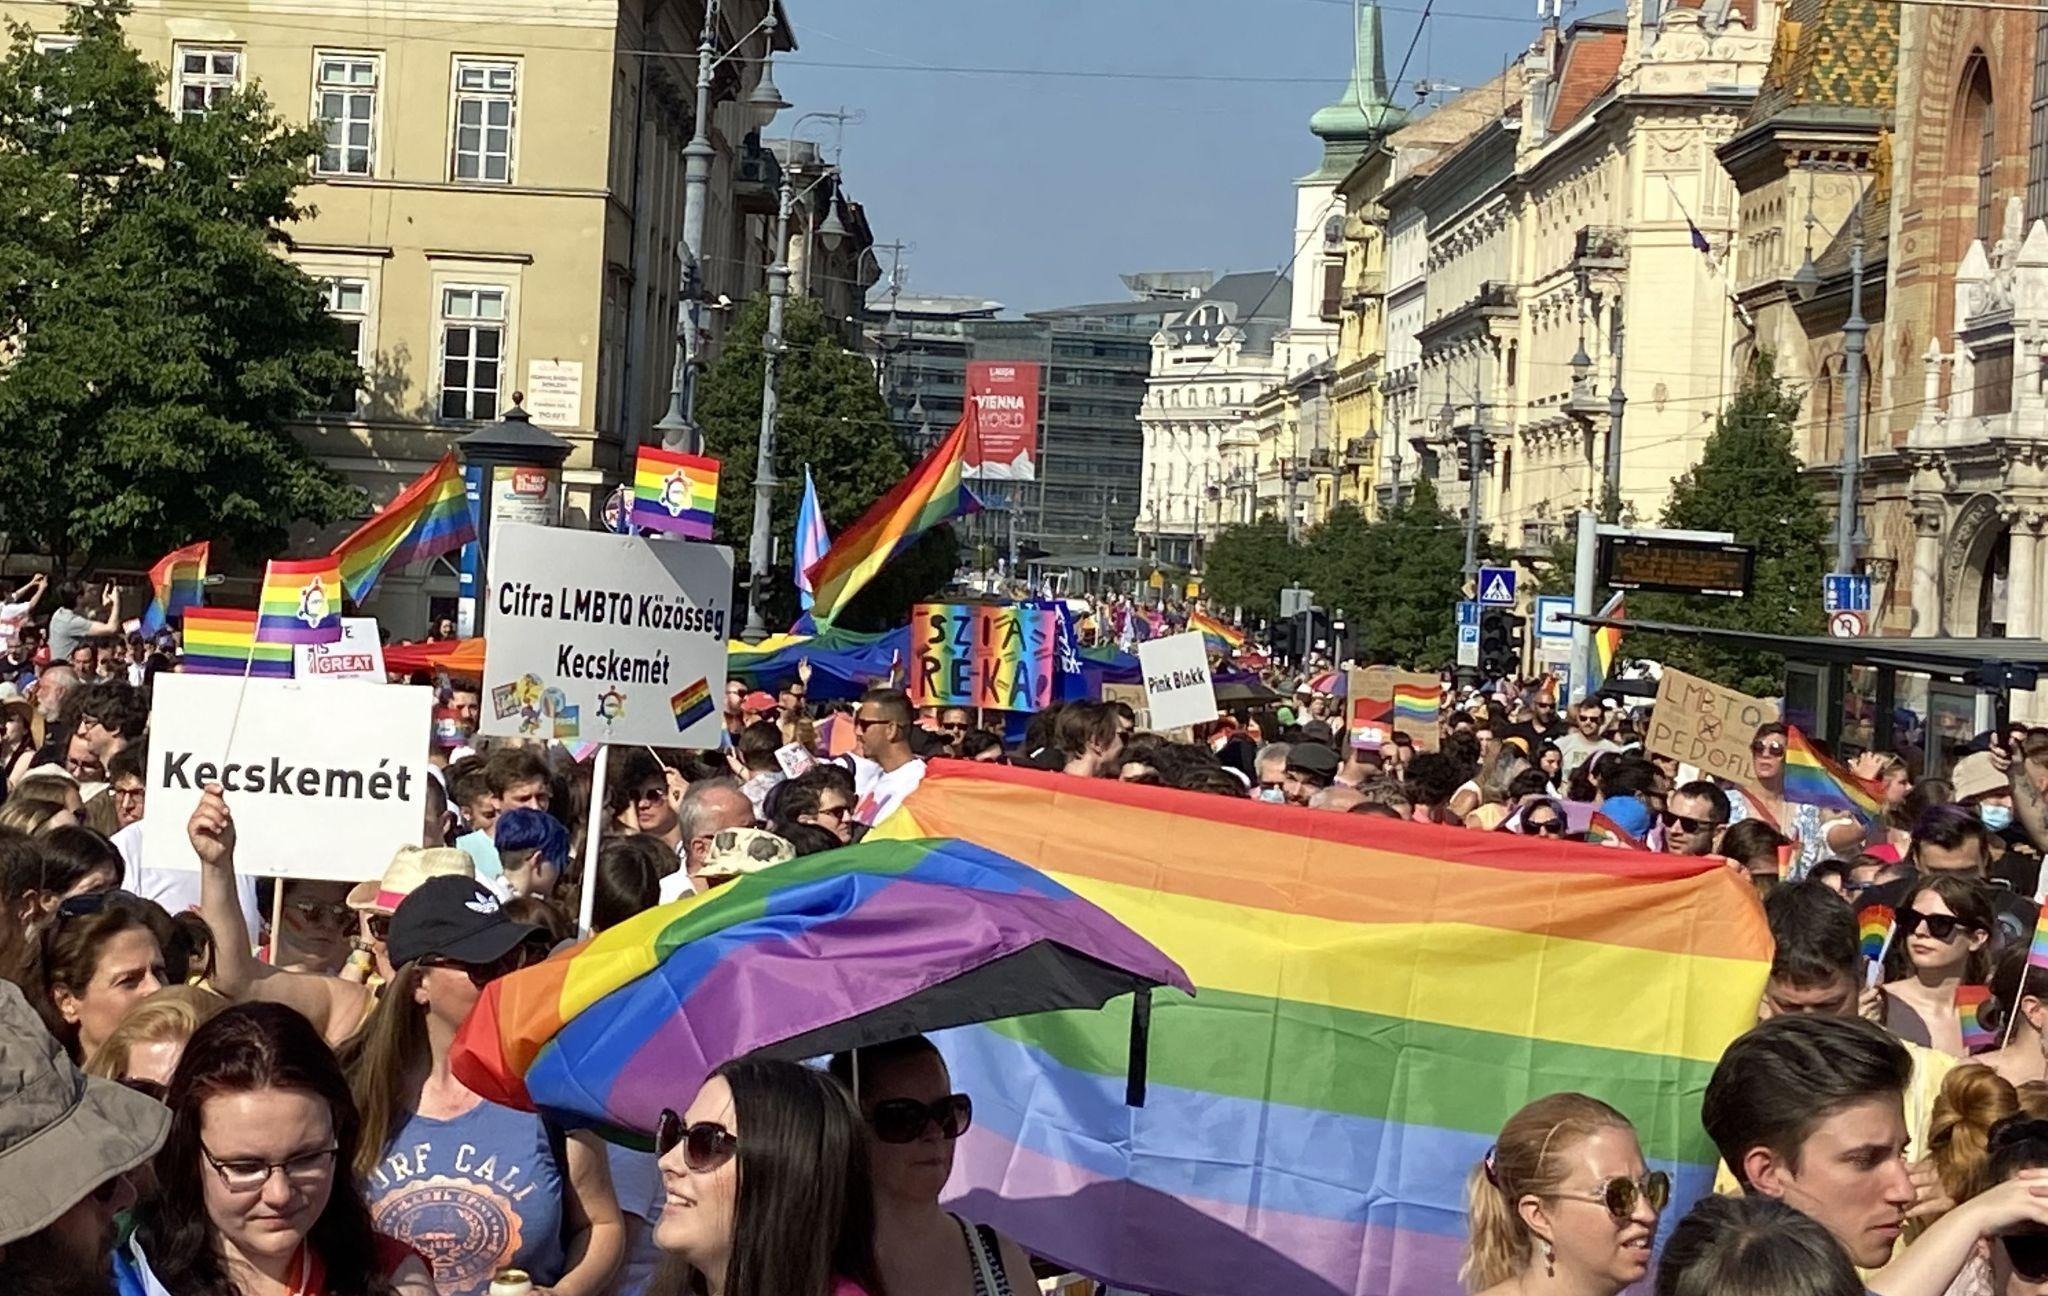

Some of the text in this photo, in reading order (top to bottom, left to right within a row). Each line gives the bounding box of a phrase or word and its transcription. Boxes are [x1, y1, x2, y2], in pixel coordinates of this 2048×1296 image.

[499, 582, 725, 641] Cifra LMBTQ Közösség
[927, 614, 1027, 652] SZIA
[319, 656, 373, 672] GREAT
[556, 644, 670, 685] Kecskemét
[1148, 674, 1172, 694] Pink
[1664, 675, 1762, 728] LMBTQ
[162, 751, 412, 802] Kecskemét
